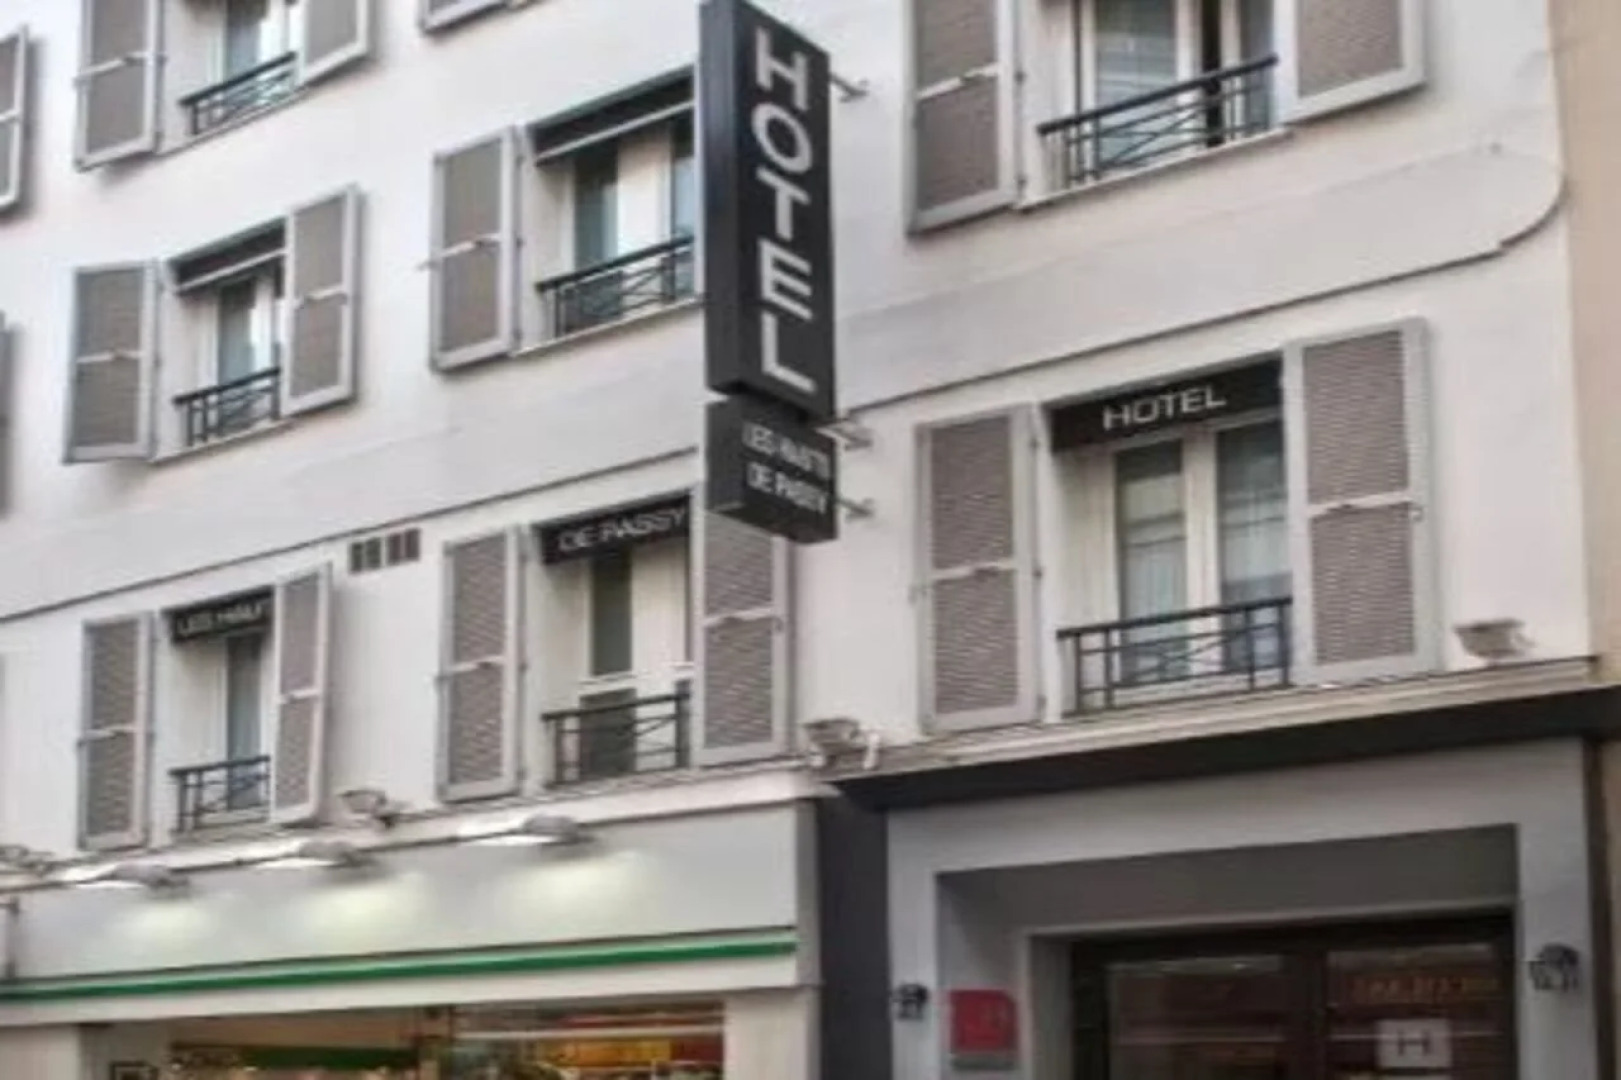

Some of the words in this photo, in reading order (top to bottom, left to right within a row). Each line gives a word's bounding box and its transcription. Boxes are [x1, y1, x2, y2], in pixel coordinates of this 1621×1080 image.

[752, 27, 816, 392] HOTEL
[1102, 385, 1227, 430] HOTEL
[747, 461, 773, 493] DE
[559, 527, 597, 552] DE
[600, 506, 686, 541] PASSY
